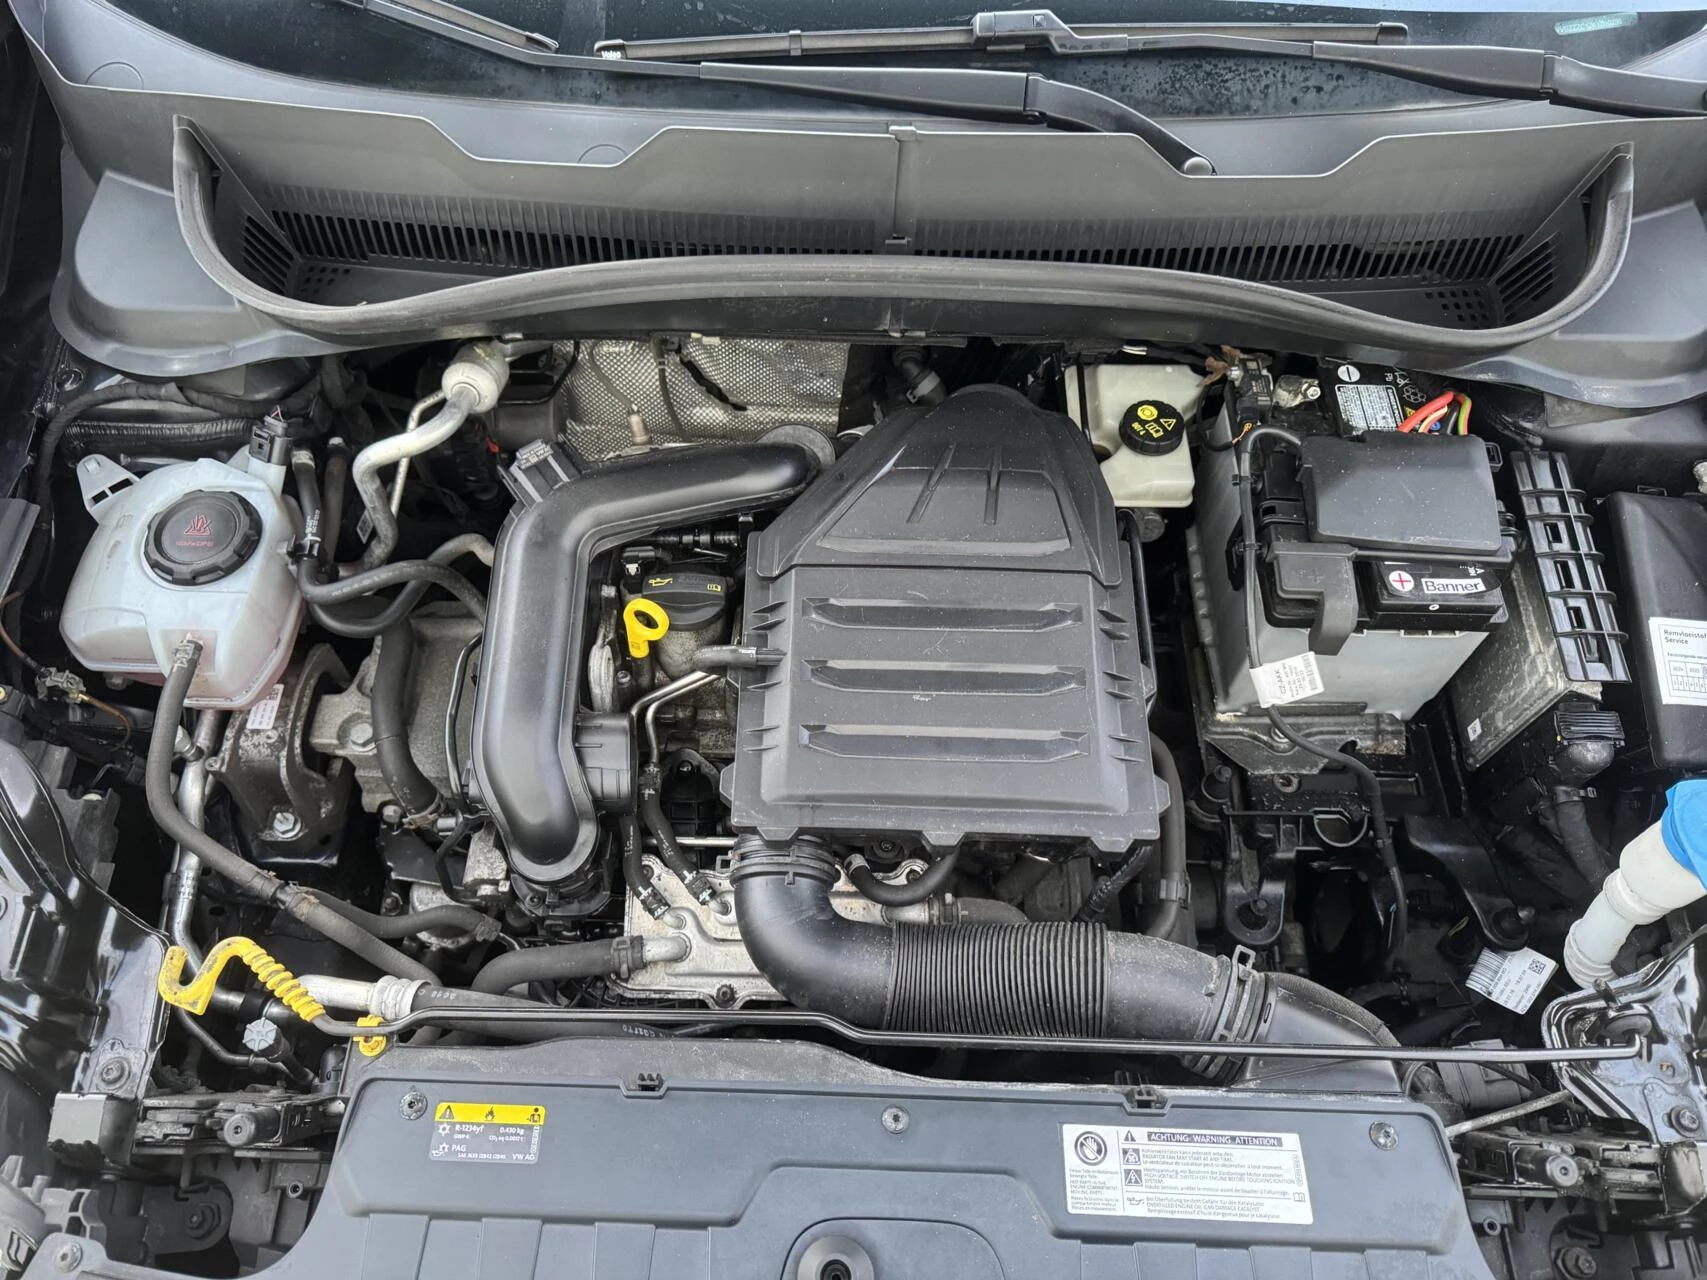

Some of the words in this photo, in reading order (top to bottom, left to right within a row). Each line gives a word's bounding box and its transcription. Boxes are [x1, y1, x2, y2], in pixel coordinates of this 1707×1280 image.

[1424, 581, 1480, 592] Banner
[455, 1124, 484, 1134] R-1234yf
[517, 1127, 525, 1135] kg
[1151, 1133, 1188, 1142] ACHTUNG
[1192, 1135, 1231, 1144] WARNING
[1235, 1136, 1278, 1146] ATTENTION
[451, 1144, 467, 1152] PAG
